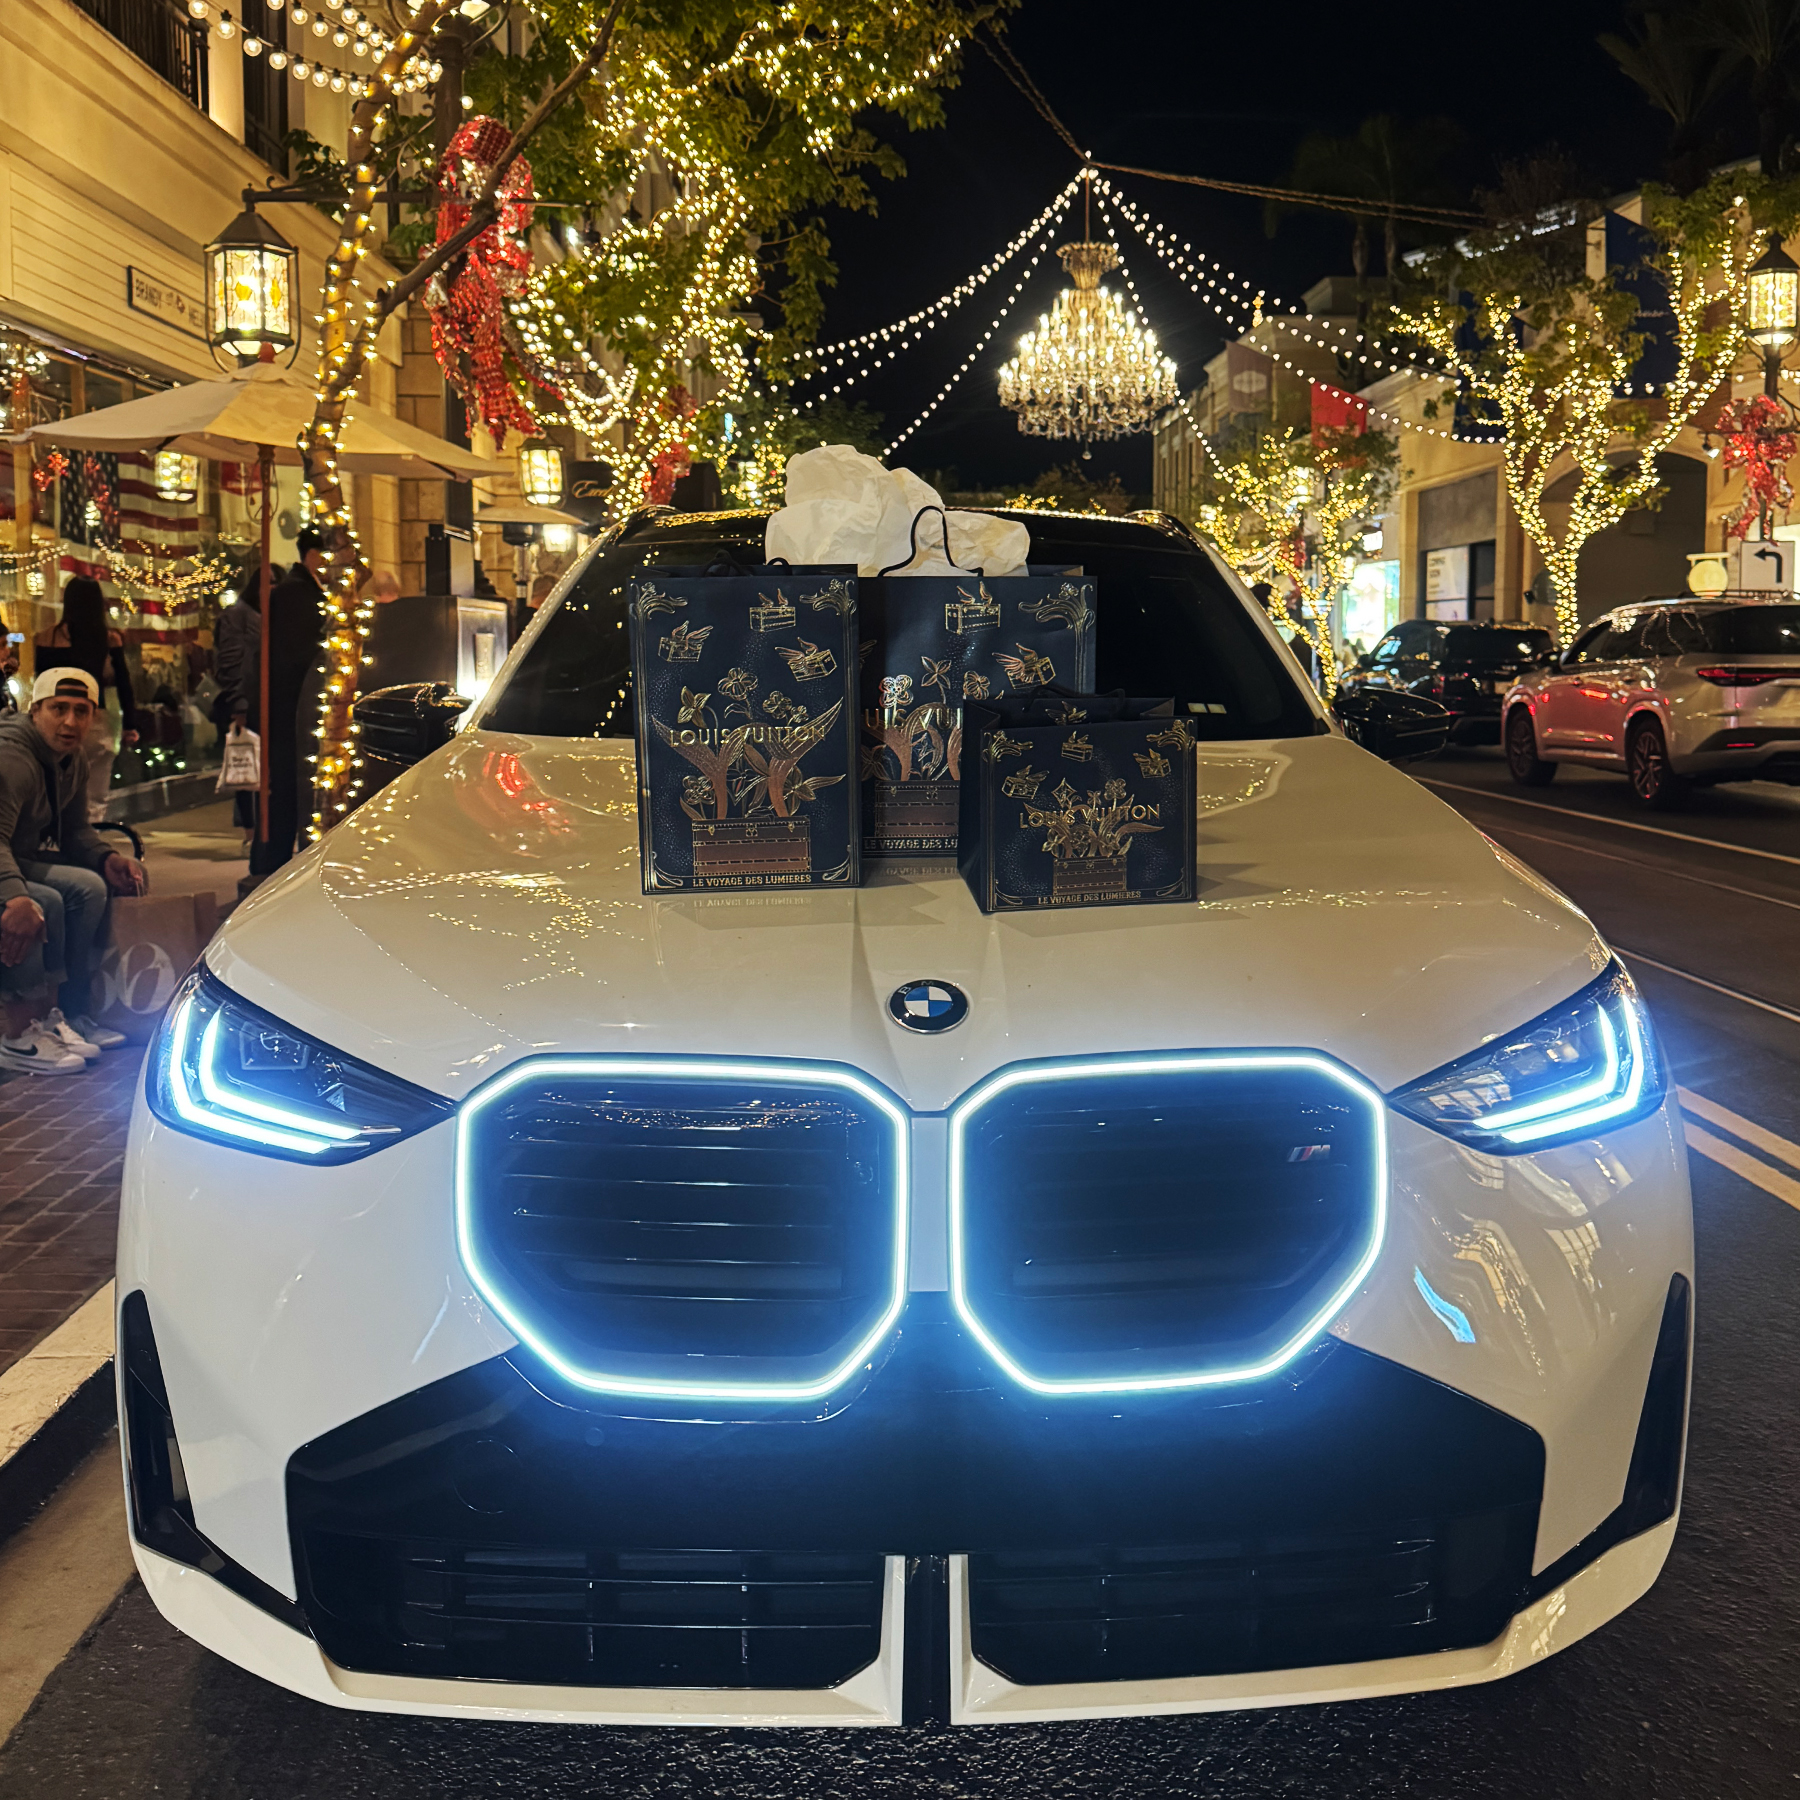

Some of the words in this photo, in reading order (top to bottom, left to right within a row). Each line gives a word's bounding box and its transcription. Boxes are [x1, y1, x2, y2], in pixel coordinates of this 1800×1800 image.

[864, 708, 907, 729] UIS
[918, 707, 963, 729] VUI
[669, 729, 731, 747] LOUIS
[1020, 809, 1075, 828] LOUIS
[880, 839, 920, 849] VOYAGE
[922, 839, 942, 849] DES
[944, 839, 958, 849] LU
[692, 878, 704, 887] LE
[706, 876, 743, 887] VOYAGE
[745, 875, 763, 885] DES
[765, 874, 811, 884] LUMIERES
[1038, 896, 1049, 905] LE
[1050, 894, 1082, 904] VOYAGE
[1083, 893, 1099, 902] DES
[1100, 891, 1141, 901] LUMIERES
